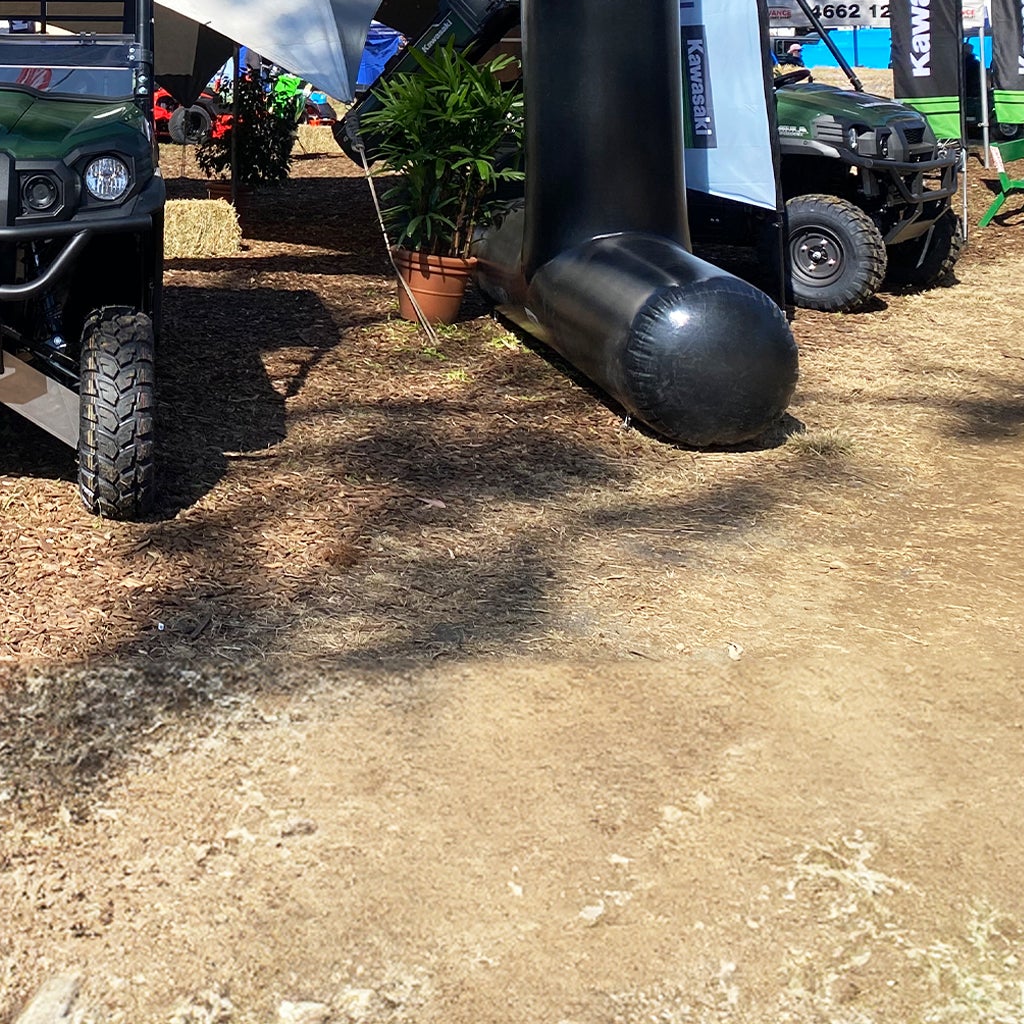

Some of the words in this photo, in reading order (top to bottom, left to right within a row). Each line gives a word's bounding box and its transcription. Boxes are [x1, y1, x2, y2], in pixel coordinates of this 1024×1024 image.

[811, 4, 861, 18] 4662
[421, 19, 453, 53] Kawasaki
[686, 39, 712, 136] Kawasaki
